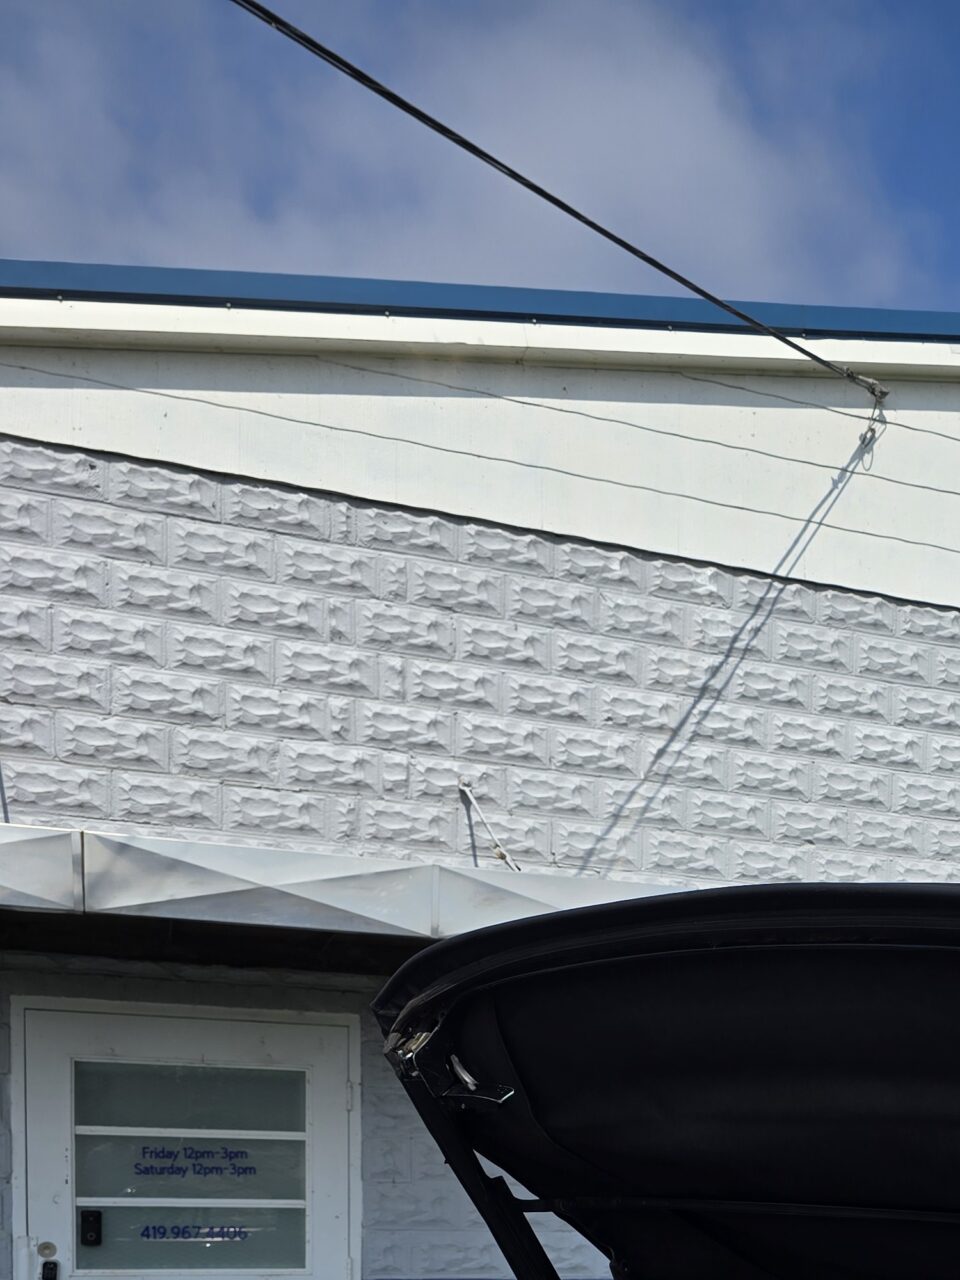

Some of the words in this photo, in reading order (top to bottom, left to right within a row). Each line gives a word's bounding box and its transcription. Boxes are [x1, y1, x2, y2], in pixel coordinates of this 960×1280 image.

[141, 1146, 180, 1162] Friday
[183, 1146, 249, 1161] 12pm-3pm
[134, 1162, 189, 1178] Saturday
[192, 1162, 257, 1177] 12pm-3pm
